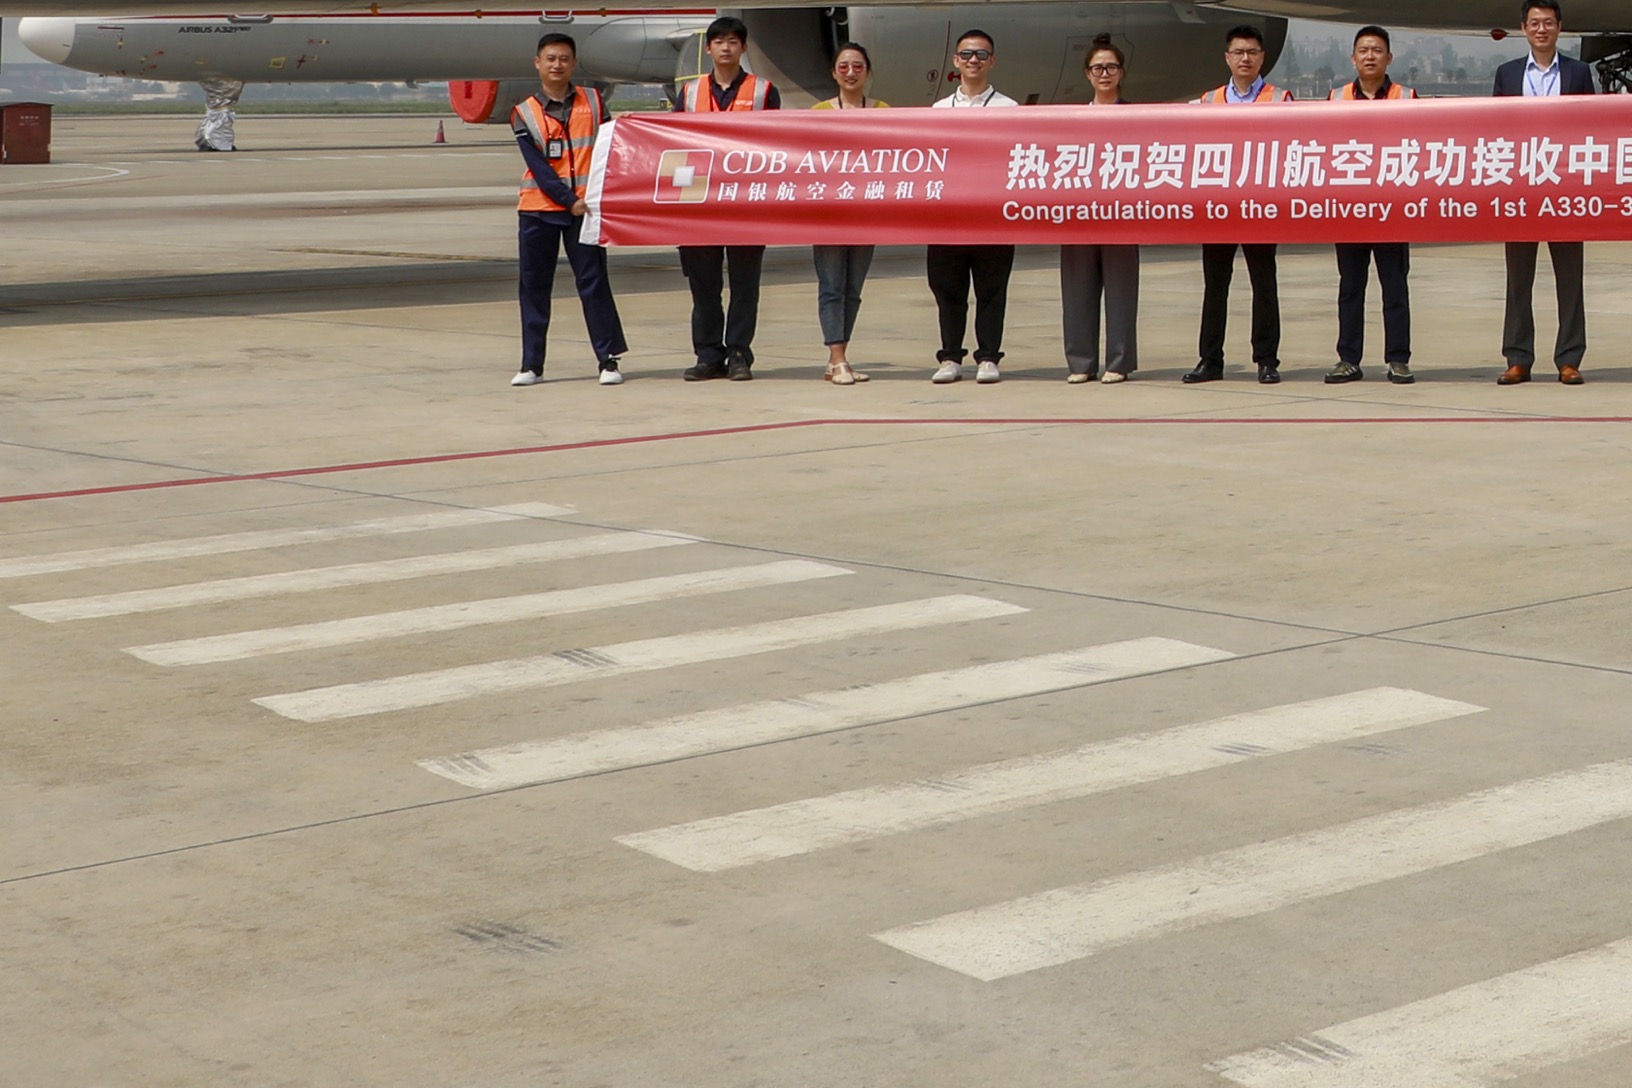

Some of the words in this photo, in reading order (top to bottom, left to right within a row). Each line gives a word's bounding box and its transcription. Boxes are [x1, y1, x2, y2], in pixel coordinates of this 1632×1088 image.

[722, 149, 788, 174] CDB
[794, 147, 949, 174] AVIATION
[716, 180, 945, 203] 国银航空金融租赁
[1002, 199, 1194, 224] Congratulations
[1206, 200, 1229, 219] to
[1240, 199, 1278, 219] the
[1291, 198, 1393, 222] Delivery
[1404, 197, 1429, 218] of
[1438, 197, 1477, 218] the
[1490, 196, 1527, 217] 1st
